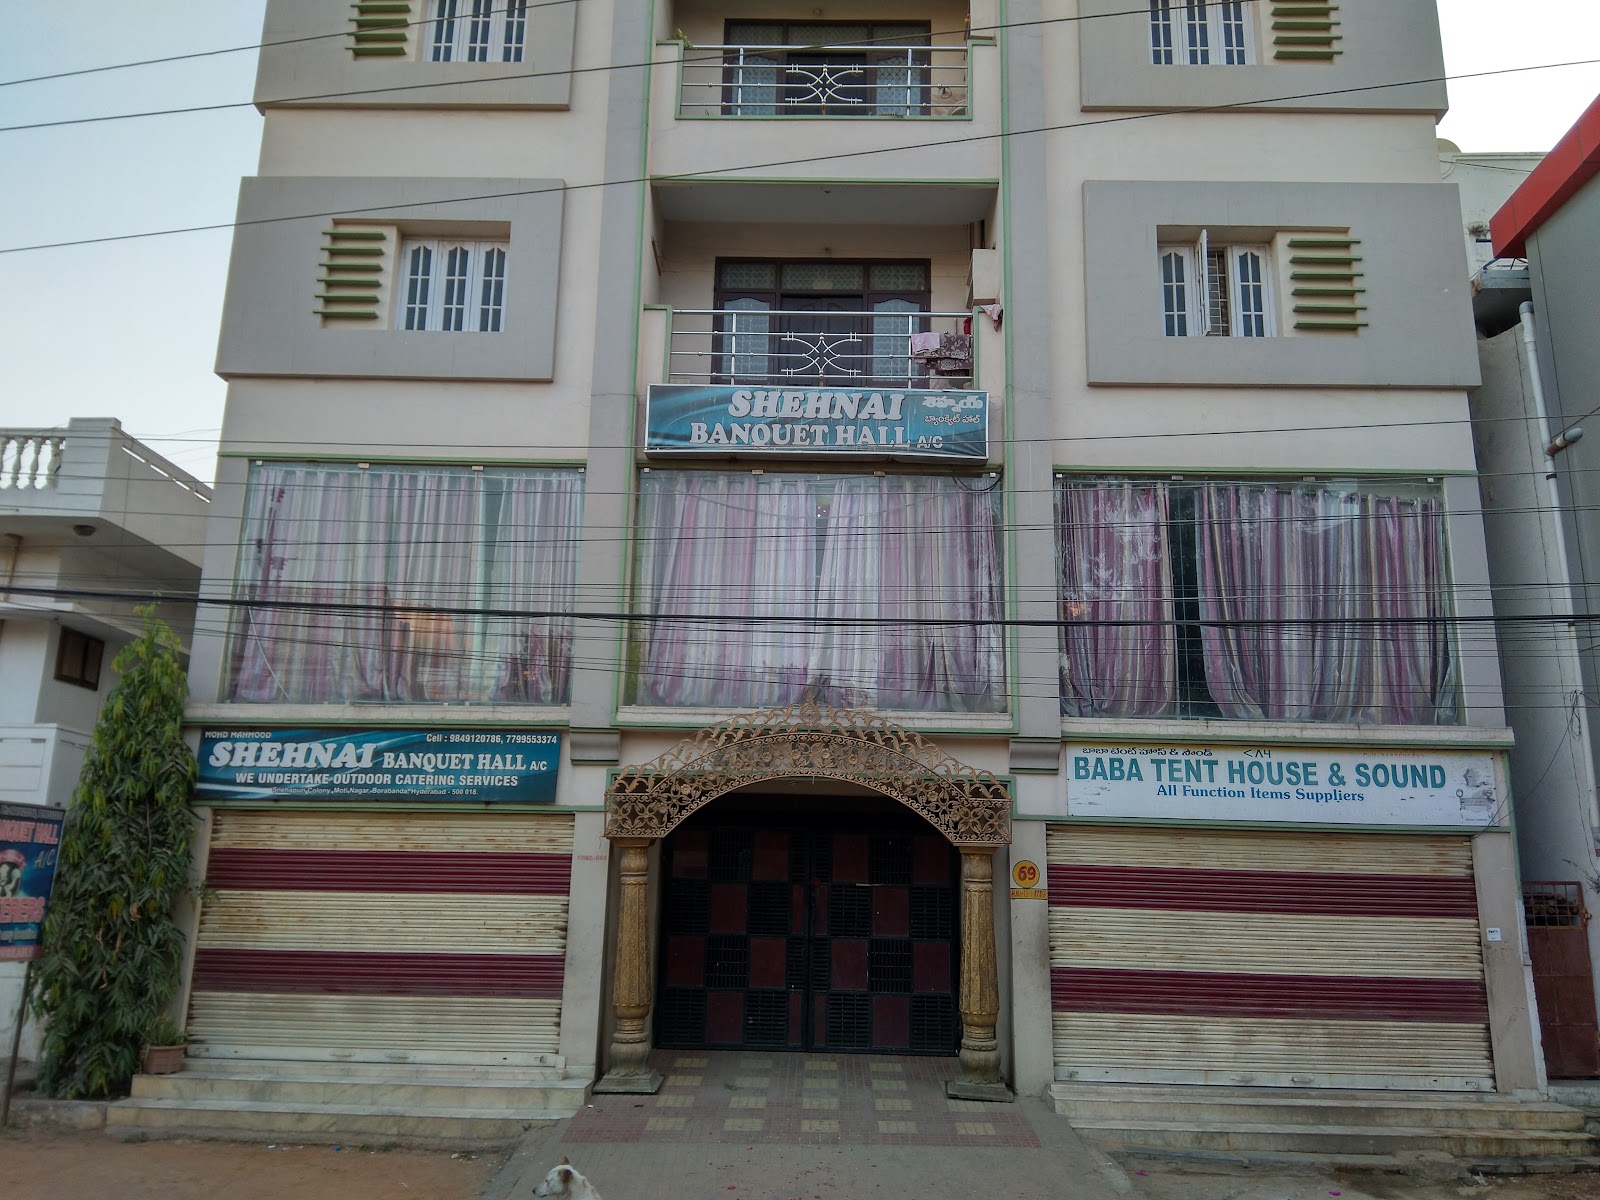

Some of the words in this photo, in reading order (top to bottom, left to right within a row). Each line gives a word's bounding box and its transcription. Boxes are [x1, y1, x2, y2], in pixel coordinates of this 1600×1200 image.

[728, 390, 905, 420] SHEHNAI
[690, 422, 828, 448] BANQUET
[835, 425, 910, 447] HALL
[917, 435, 943, 448] A/C
[205, 731, 228, 739] MOHD
[230, 731, 272, 739] MAHMOOD
[426, 733, 443, 742] Cell
[506, 735, 557, 744] 7799553374
[209, 741, 377, 768] SHEHNAI
[382, 752, 474, 772] BANQUET
[477, 754, 527, 771] HALL
[529, 761, 547, 771] A/C
[235, 773, 254, 784] WE
[258, 773, 329, 785] UNDERTAKE
[333, 773, 391, 785] OUTDOOR
[395, 774, 455, 785] CATERING
[459, 775, 518, 786] SERVICES
[1074, 756, 1143, 781] BABA
[1151, 758, 1218, 783] TENT
[1227, 760, 1318, 786] HOUSE
[1328, 762, 1346, 787] &
[1355, 763, 1446, 789] SOUND
[1157, 784, 1177, 796] All
[1182, 785, 1245, 798] Function
[1250, 786, 1290, 800] Items
[1296, 788, 1364, 803] Suppliers
[1018, 865, 1036, 881] 69
